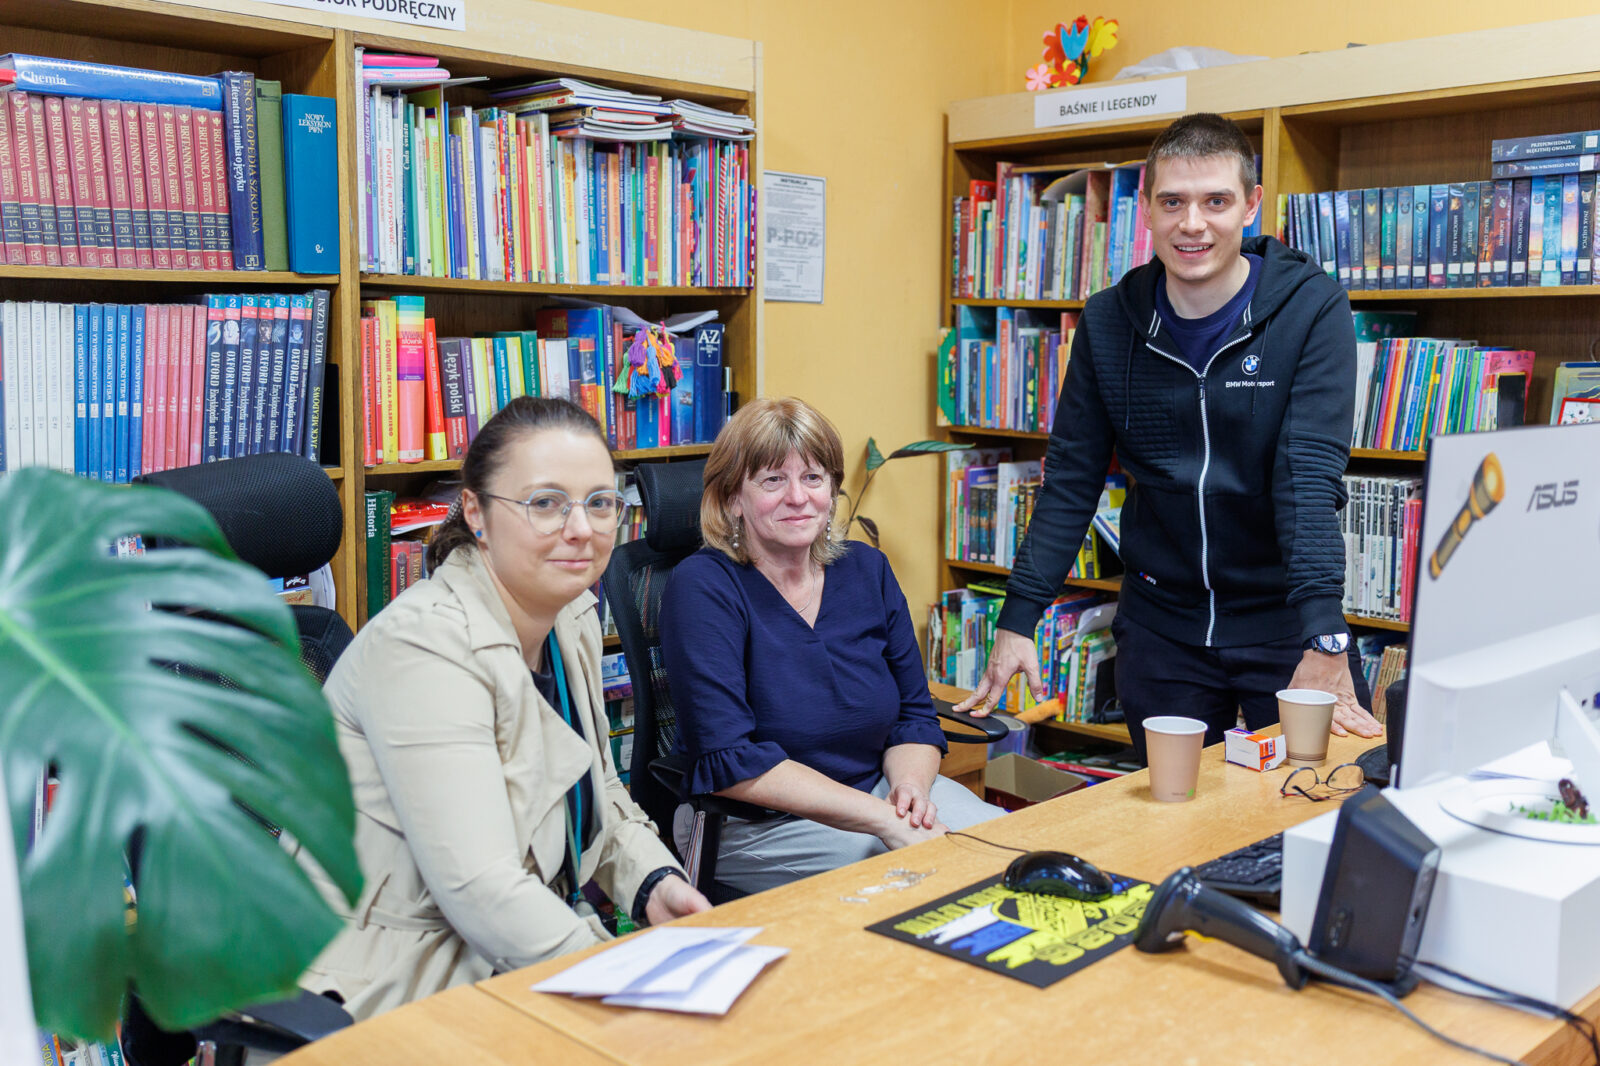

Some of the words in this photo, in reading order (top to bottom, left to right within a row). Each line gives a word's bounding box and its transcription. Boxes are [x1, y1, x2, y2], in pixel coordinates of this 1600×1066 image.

[362, 0, 457, 21] PODRĘCZNY
[20, 70, 67, 86] Chemia
[230, 79, 244, 124] Literatura
[1060, 101, 1098, 117] BAŚNIE
[1101, 101, 1105, 112] I
[1107, 94, 1158, 111] LEGENDY
[244, 79, 257, 176] ENCYKLOPEDIA
[298, 118, 332, 129] LEKSYKON
[304, 113, 325, 122] NOWY
[15, 110, 28, 168] BRITANNICA
[308, 126, 323, 134] PWN
[32, 113, 46, 170] BRITANNICA
[52, 115, 67, 171] BRITANNICA
[72, 115, 86, 171] BRITANNICA
[88, 118, 102, 173] BRITANNICA
[109, 119, 122, 174] BRITANNICA
[128, 121, 141, 175] BRITANNICA
[146, 121, 159, 176] BRITANNICA
[164, 122, 176, 177] BRITANNICA
[181, 125, 193, 179] BRITANNICA
[234, 129, 243, 157] nauka
[1551, 144, 1576, 152] GWIAZDY
[198, 126, 210, 180] BRITANNICA
[213, 128, 224, 181] BRITANNICA
[232, 162, 246, 192] języku
[249, 178, 261, 234] SZKOLNA
[9, 220, 18, 228] 14
[28, 222, 38, 231] 15
[45, 222, 54, 231] 16
[64, 223, 73, 231] 17
[84, 224, 93, 232] 18
[100, 224, 110, 233] 19
[120, 226, 130, 234] 20
[138, 226, 147, 235] 21
[156, 227, 165, 235] 22
[173, 228, 182, 236] 23
[190, 229, 199, 237] 24
[206, 230, 215, 238] 25
[221, 230, 229, 238] 26
[1581, 225, 1589, 250] KSIĘŻYCA
[214, 298, 220, 308] 1
[229, 298, 237, 308] 2
[246, 296, 255, 306] 3
[263, 298, 272, 308] 4
[279, 296, 287, 306] 5
[295, 299, 303, 308] 6
[306, 299, 313, 308] 7
[77, 315, 85, 331] DZIECI
[105, 316, 113, 332] DZIECI
[119, 315, 127, 331] DZIECI
[315, 297, 326, 329] UCZENI
[134, 317, 142, 333] DZIECI
[77, 333, 85, 343] DLA
[105, 334, 113, 343] DLA
[119, 333, 127, 342] DLA
[134, 334, 142, 344] DLA
[77, 343, 85, 380] ENCYKLOPEDIA
[105, 345, 113, 380] ENCYKLOPEDIA
[119, 344, 127, 378] ENCYKLOPEDIA
[134, 345, 142, 380] ENCYKLOPEDIA
[210, 352, 221, 387] OXFORD
[226, 350, 236, 385] OXFORD
[242, 348, 253, 383] OXFORD
[259, 350, 270, 384] OXFORD
[273, 348, 284, 383] OXFORD
[290, 348, 301, 382] OXFORD
[444, 352, 461, 381] Język
[134, 380, 142, 400] WIELKA
[269, 384, 281, 418] Encyklopedia
[285, 383, 299, 418] Encyklopedia
[446, 382, 464, 414] polski
[206, 388, 219, 424] Encyklopedia
[221, 388, 234, 423] Encyklopedia
[237, 385, 250, 420] Encyklopedia
[254, 386, 267, 421] Encyklopedia
[311, 387, 321, 428] MEADOWS
[208, 425, 217, 447] szkolna
[223, 424, 232, 446] szkolna
[238, 422, 248, 443] szkolna
[255, 422, 264, 443] szkolna
[270, 419, 278, 440] szkolna
[286, 418, 295, 439] szkolna
[310, 428, 320, 449] JACK
[1526, 480, 1580, 513] ASUS
[367, 497, 377, 538] Historia
[381, 497, 390, 583] ENCYKLOPEDIA
